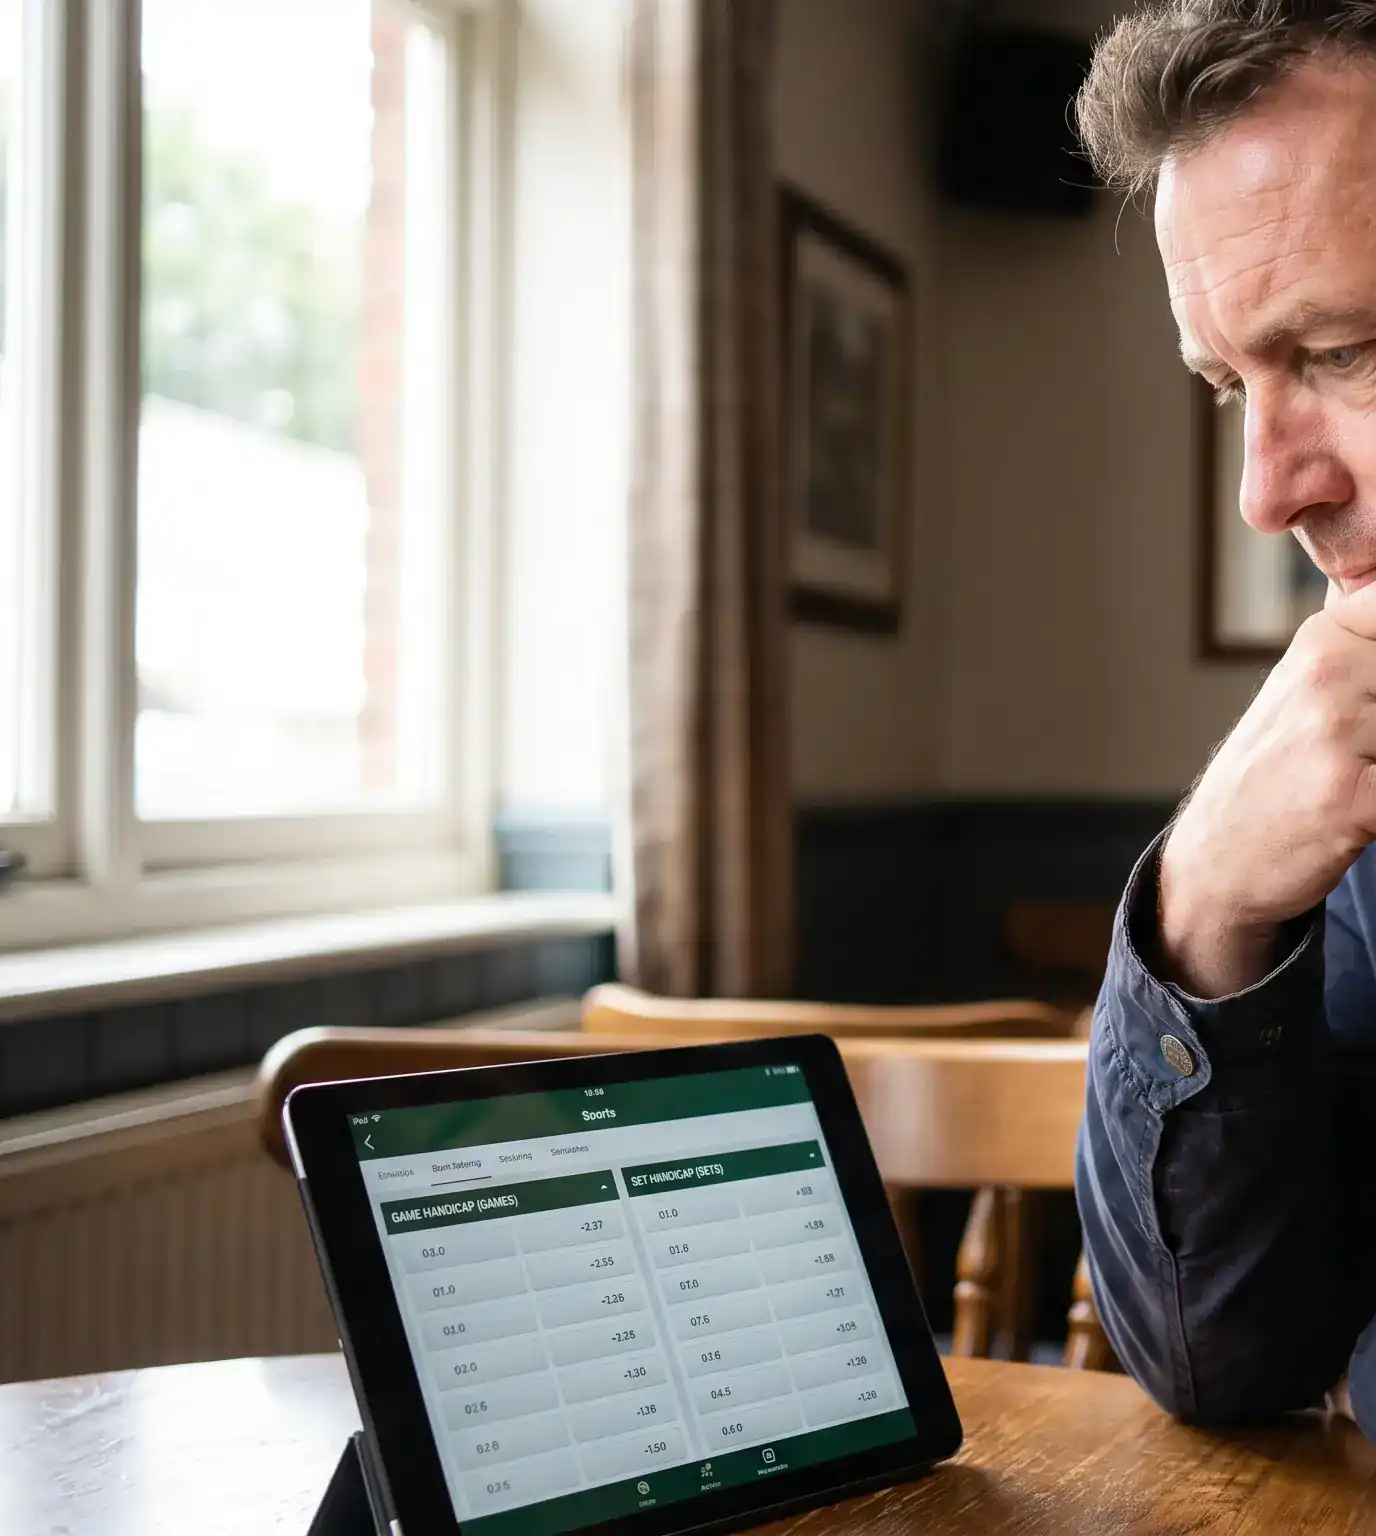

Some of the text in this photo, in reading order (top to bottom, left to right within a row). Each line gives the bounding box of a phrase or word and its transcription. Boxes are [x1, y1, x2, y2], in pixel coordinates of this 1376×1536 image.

[630, 1175, 648, 1187] SET
[695, 1164, 724, 1178] (SETS)
[391, 1194, 519, 1223] GAME HANDICAP (GAMES)
[580, 1220, 603, 1231] -2.37
[711, 1387, 731, 1399] 04.5
